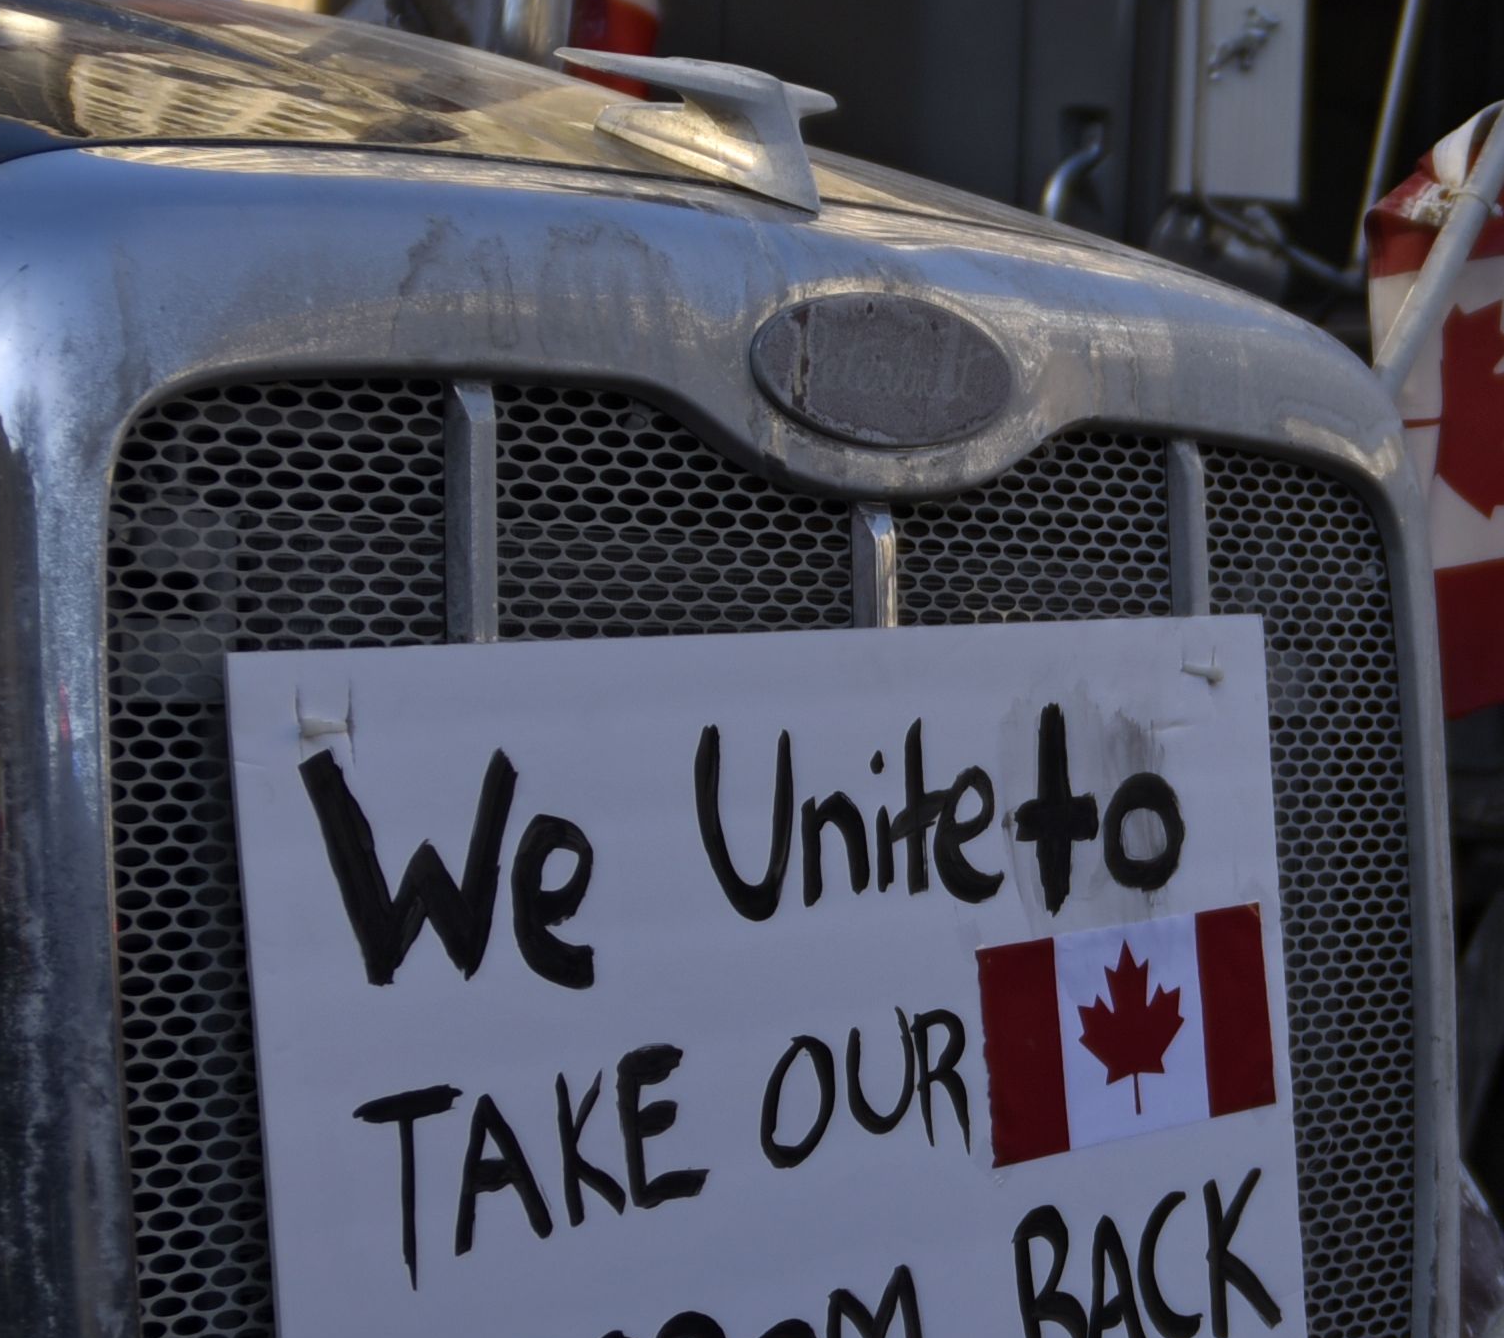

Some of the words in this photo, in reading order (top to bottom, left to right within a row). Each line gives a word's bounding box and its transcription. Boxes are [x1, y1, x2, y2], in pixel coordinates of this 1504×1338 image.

[298, 748, 595, 990] We
[694, 718, 1005, 922] Unite
[1013, 703, 1186, 917] to
[353, 1044, 710, 1291] TAKE
[760, 1006, 971, 1169] OUR
